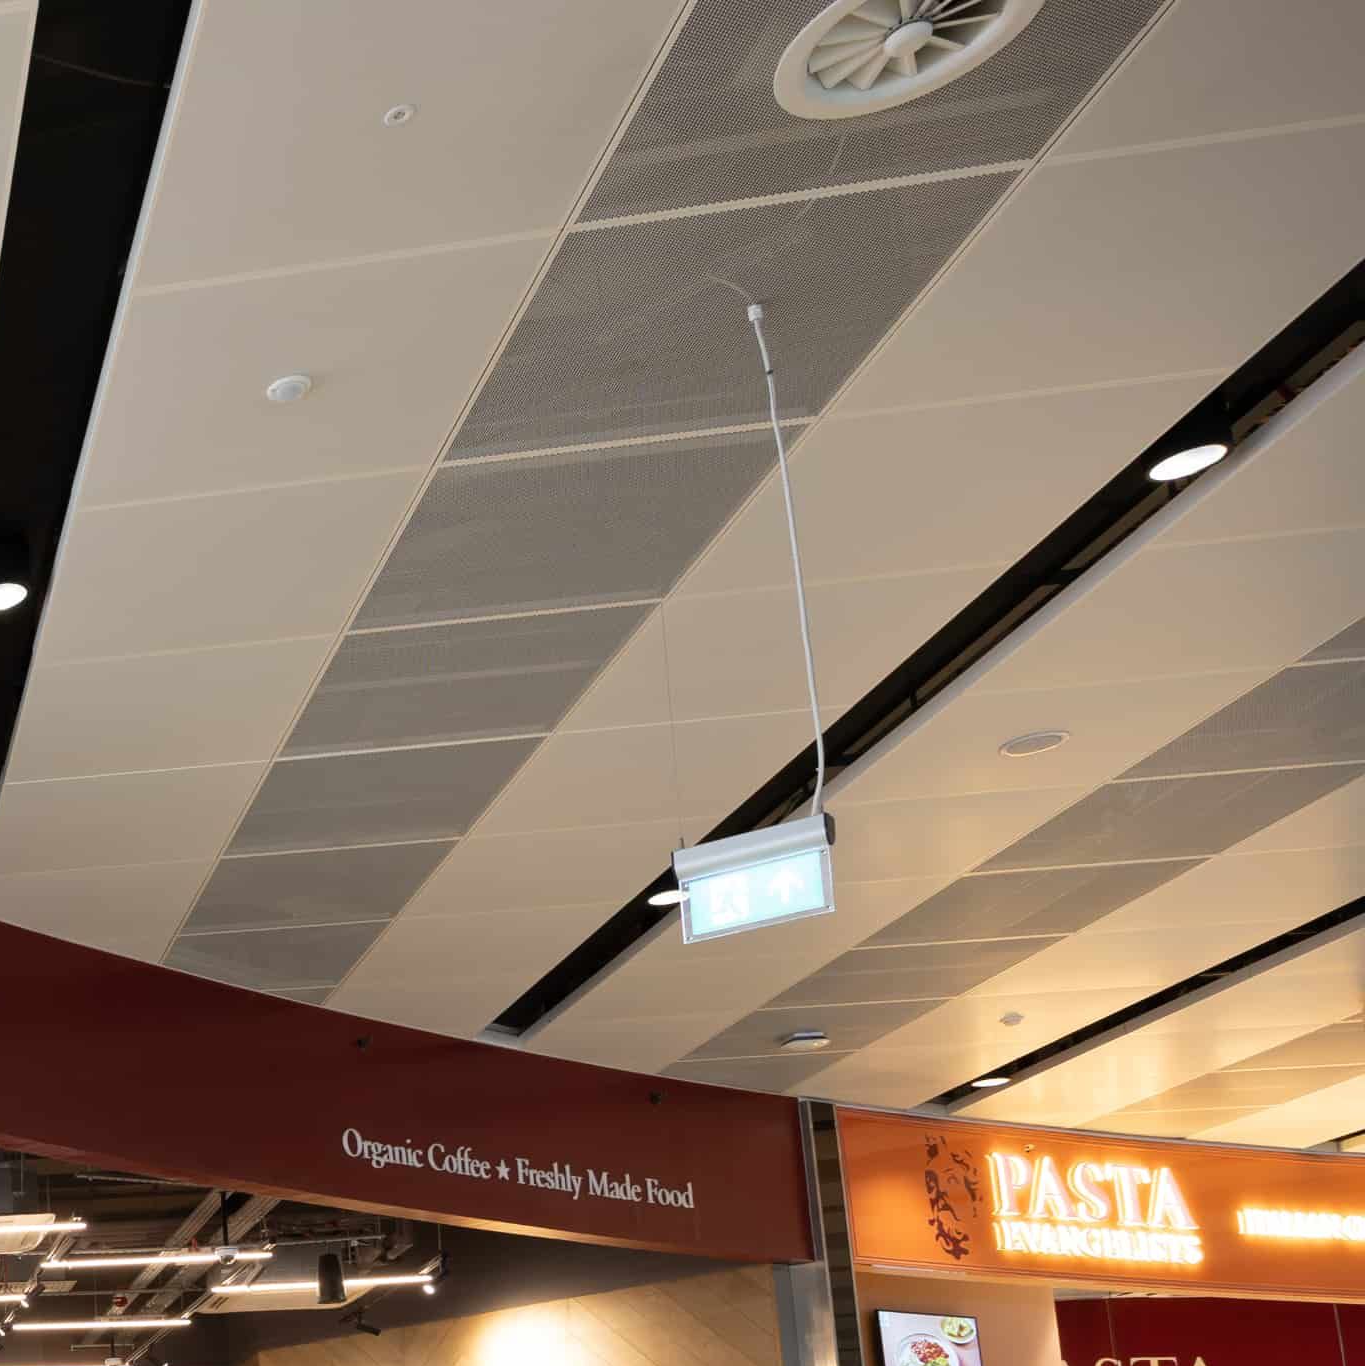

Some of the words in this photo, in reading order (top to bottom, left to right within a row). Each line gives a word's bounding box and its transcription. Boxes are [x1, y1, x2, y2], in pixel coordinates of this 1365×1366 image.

[341, 1128, 424, 1169] Organic
[427, 1143, 492, 1180] Coffee
[516, 1157, 582, 1200] Freshly
[587, 1168, 642, 1202] Made
[645, 1177, 695, 1209] Food
[986, 1152, 1201, 1230] PASTA
